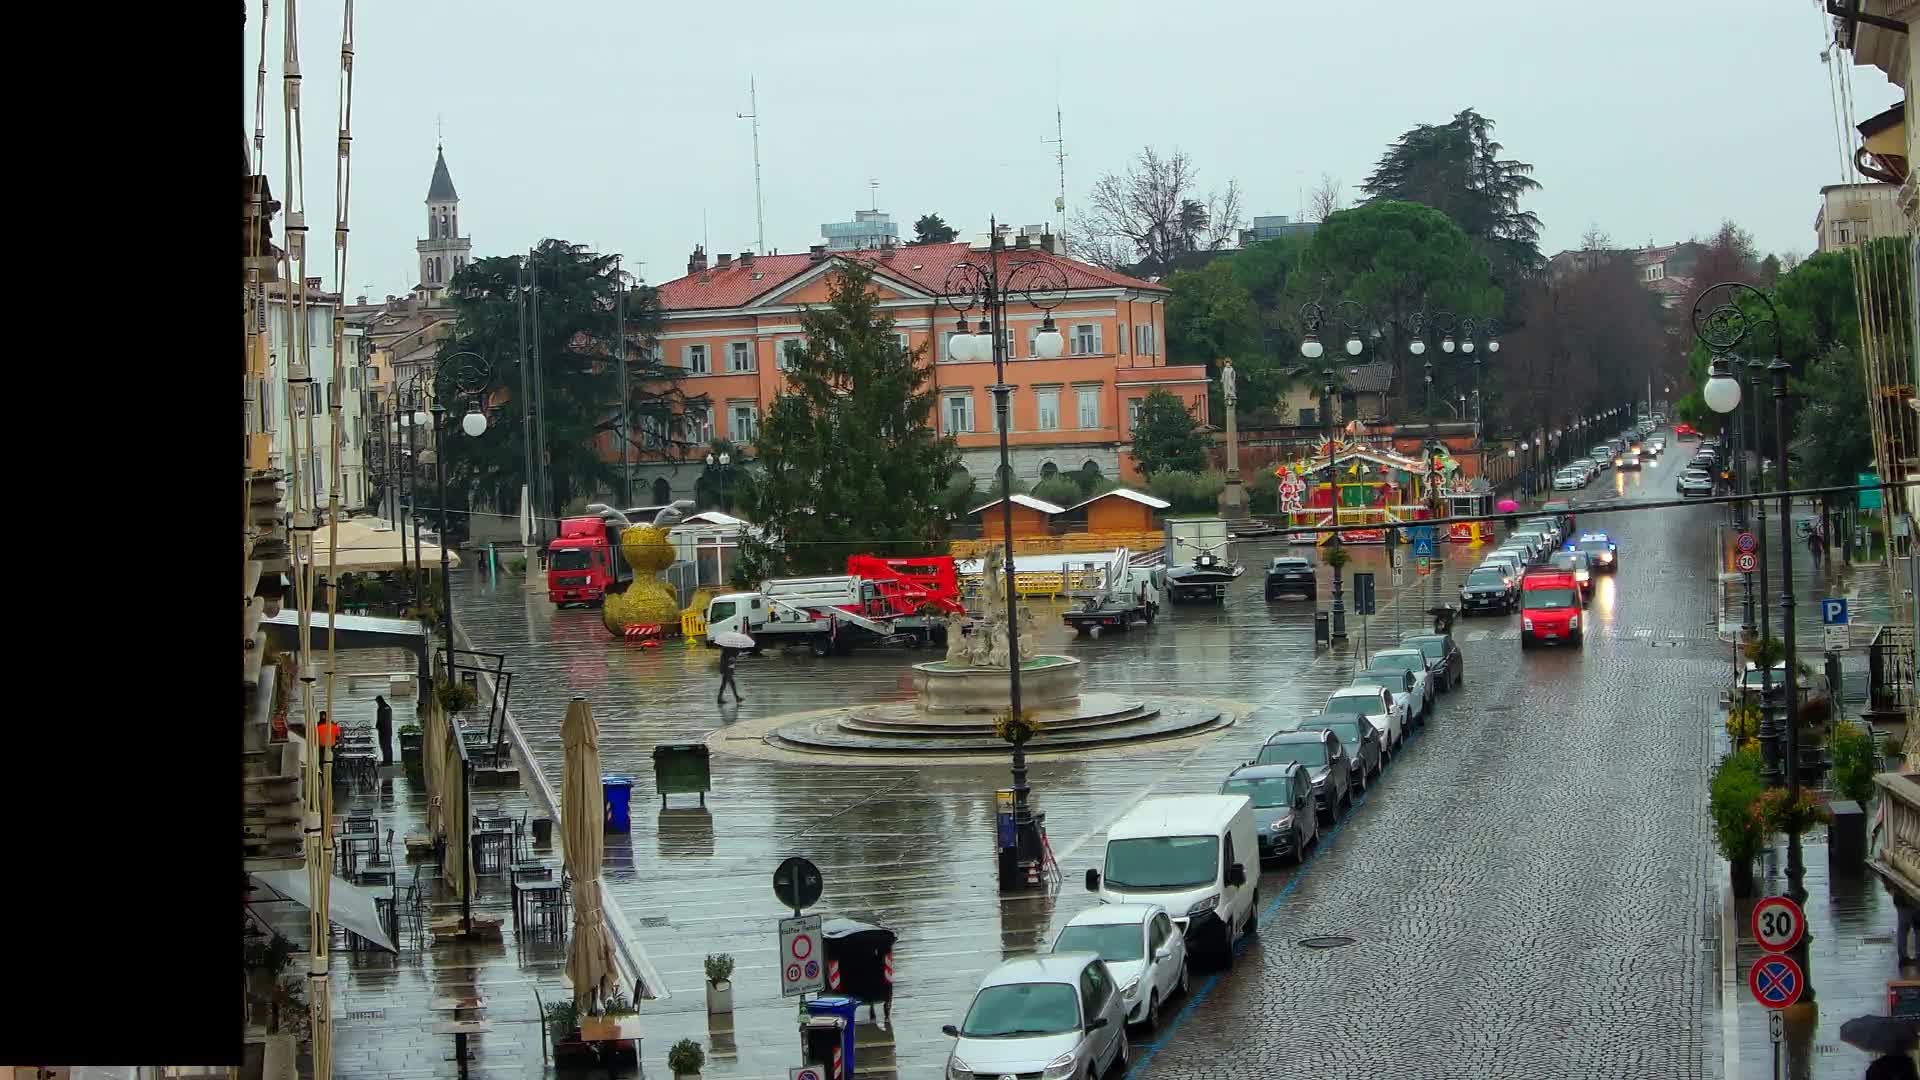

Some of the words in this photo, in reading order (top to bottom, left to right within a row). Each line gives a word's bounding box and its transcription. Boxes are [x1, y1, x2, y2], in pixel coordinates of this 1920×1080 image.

[1742, 557, 1753, 567] 20
[1827, 602, 1842, 621] P
[1762, 911, 1792, 938] 30
[790, 968, 799, 978] 10
